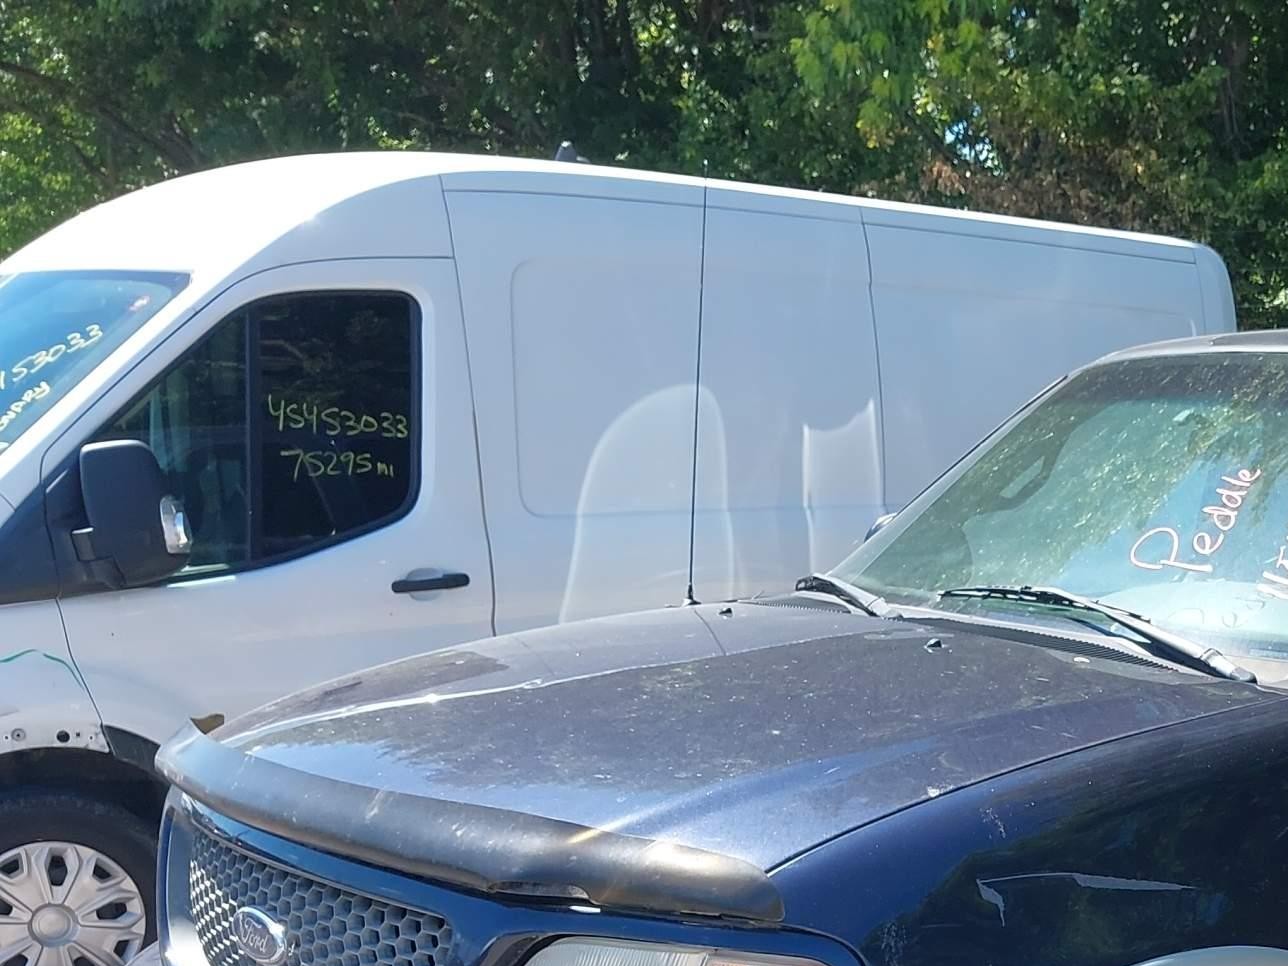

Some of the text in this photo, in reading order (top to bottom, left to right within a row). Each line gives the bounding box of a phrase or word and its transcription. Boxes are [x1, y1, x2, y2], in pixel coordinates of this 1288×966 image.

[267, 394, 409, 438] 45453033
[280, 448, 373, 482] 75295
[1129, 465, 1261, 573] Peddle
